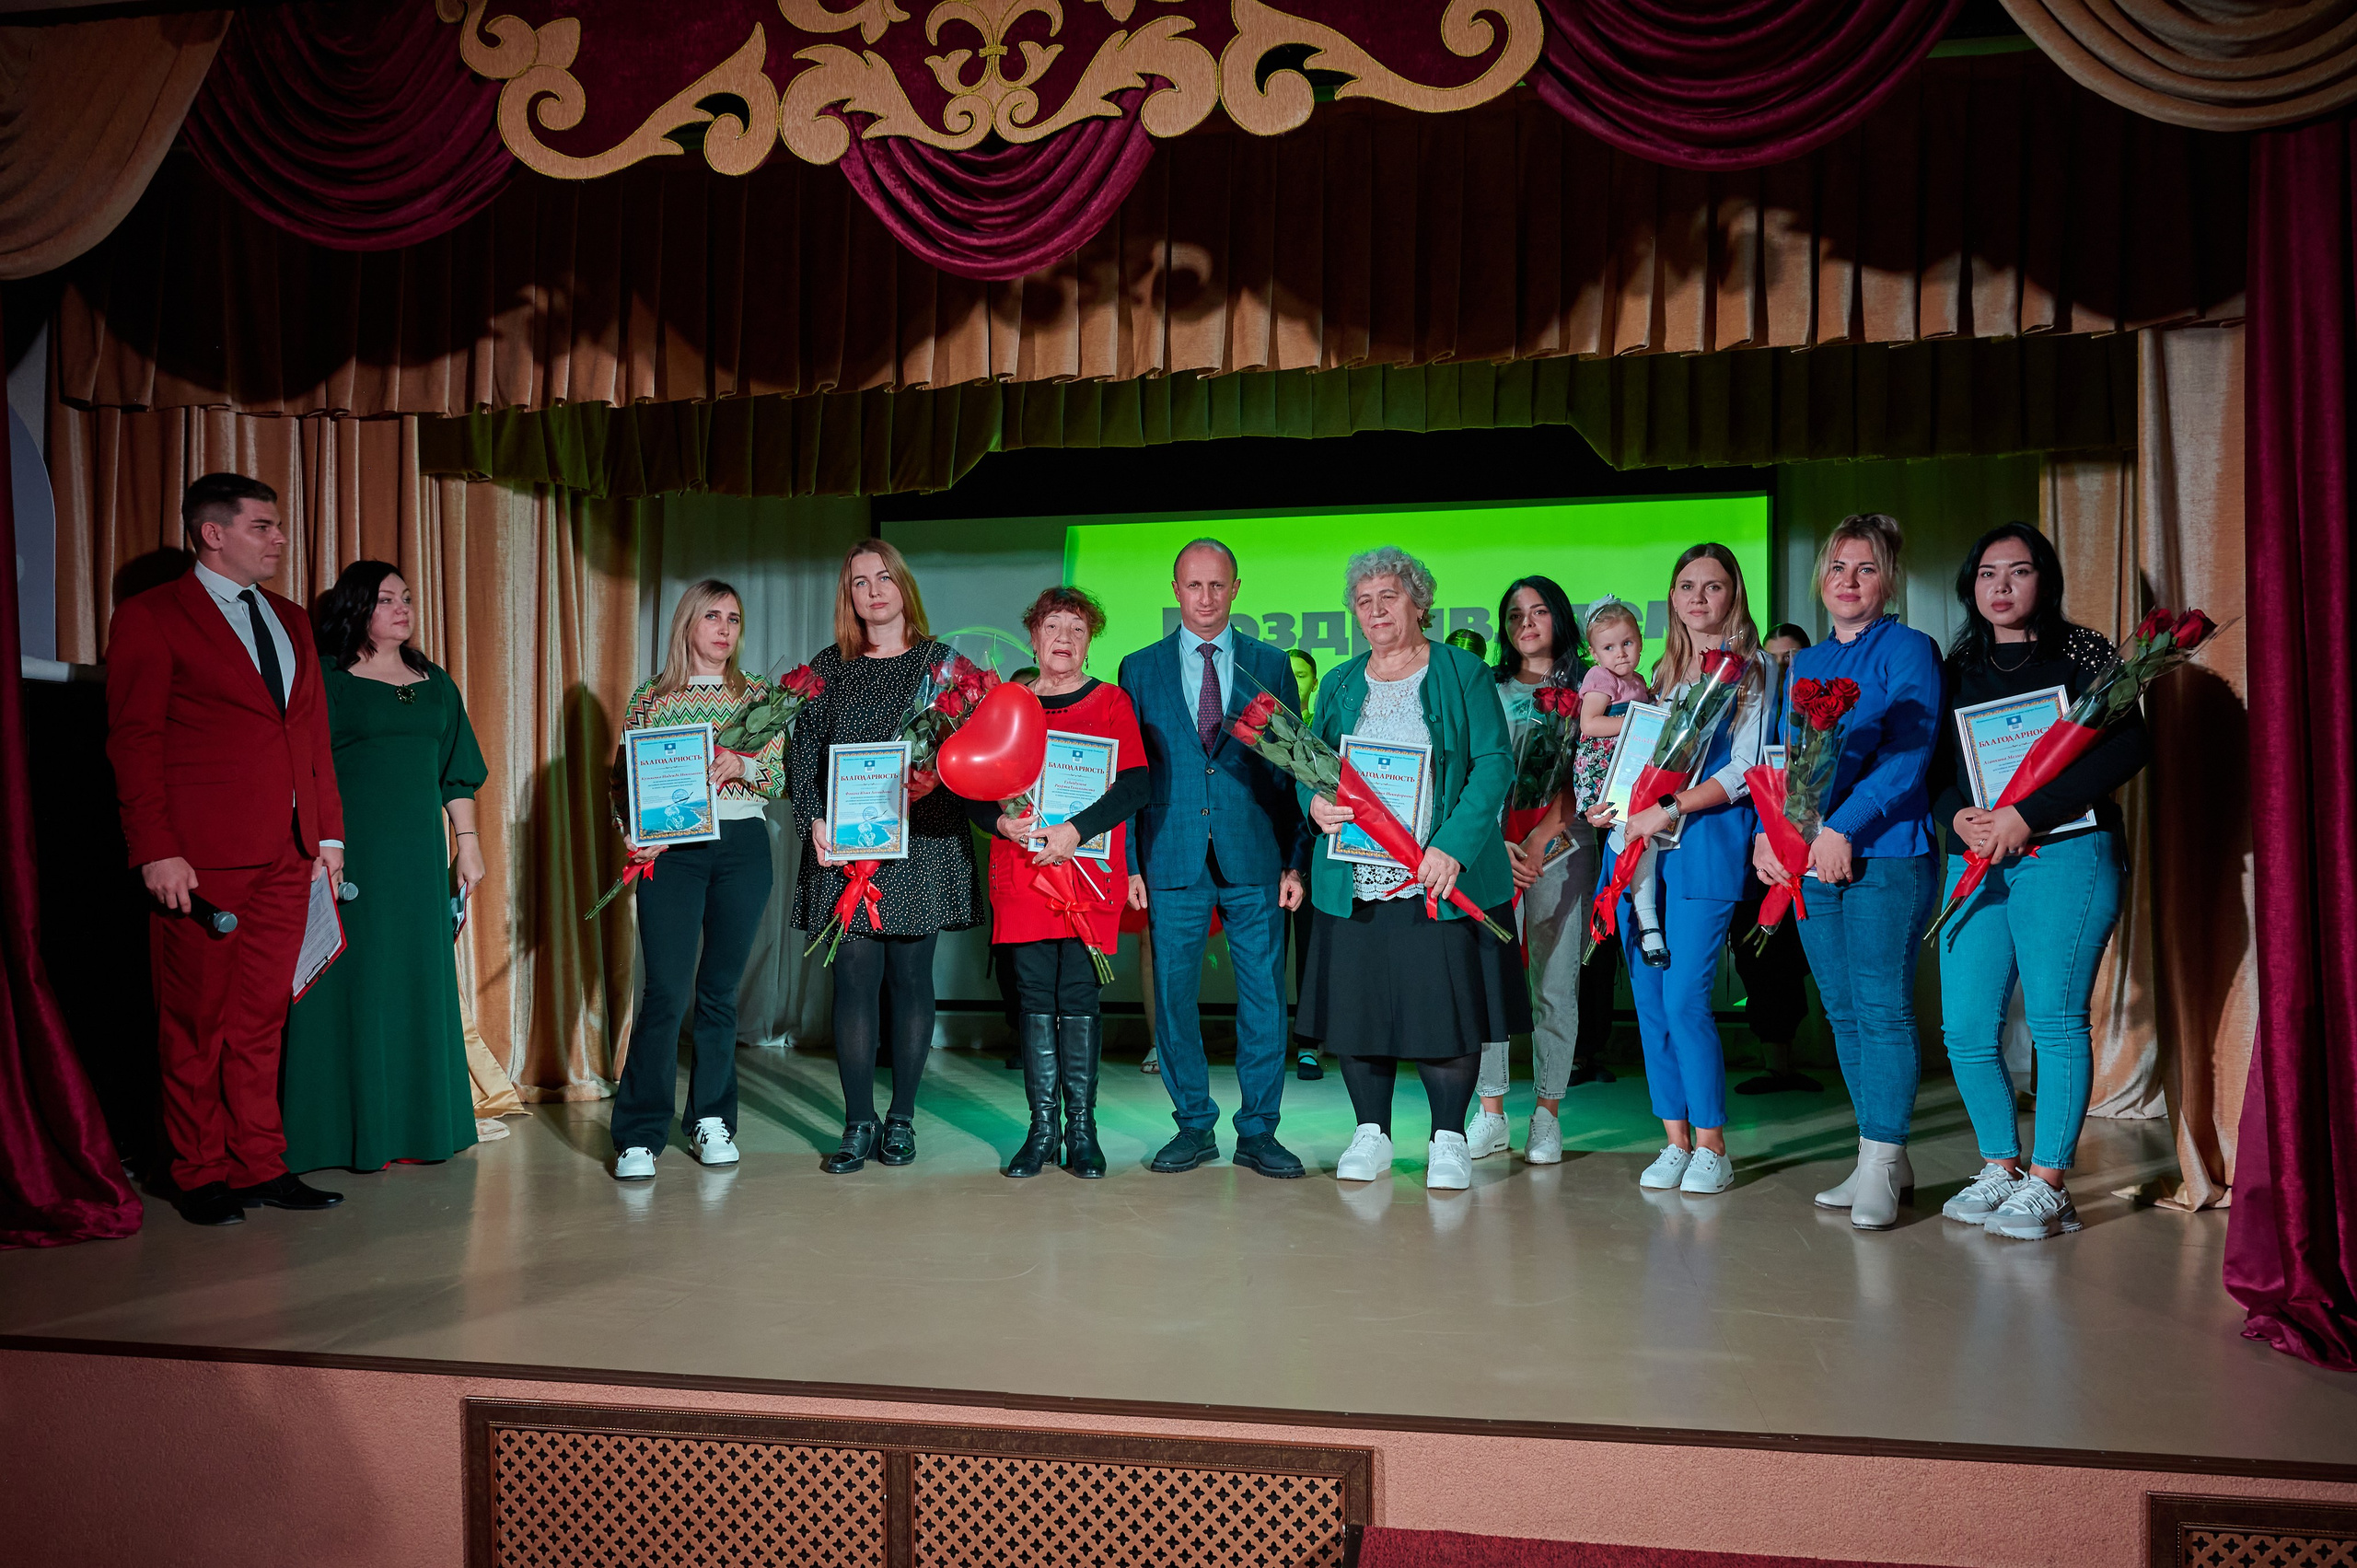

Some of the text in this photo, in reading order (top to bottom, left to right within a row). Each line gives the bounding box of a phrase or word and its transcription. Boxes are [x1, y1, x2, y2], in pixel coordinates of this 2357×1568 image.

[1979, 726, 2050, 748] БЛАГОДАРНОС
[640, 754, 702, 766] БЛАГОДАРНОСТЬ
[1048, 761, 1105, 774] БЛАГОДАРНОСТЬ
[841, 772, 899, 782] БЛАГОДАРНОСТЬ
[1356, 770, 1415, 783] АГОДАРНОСТЬ
